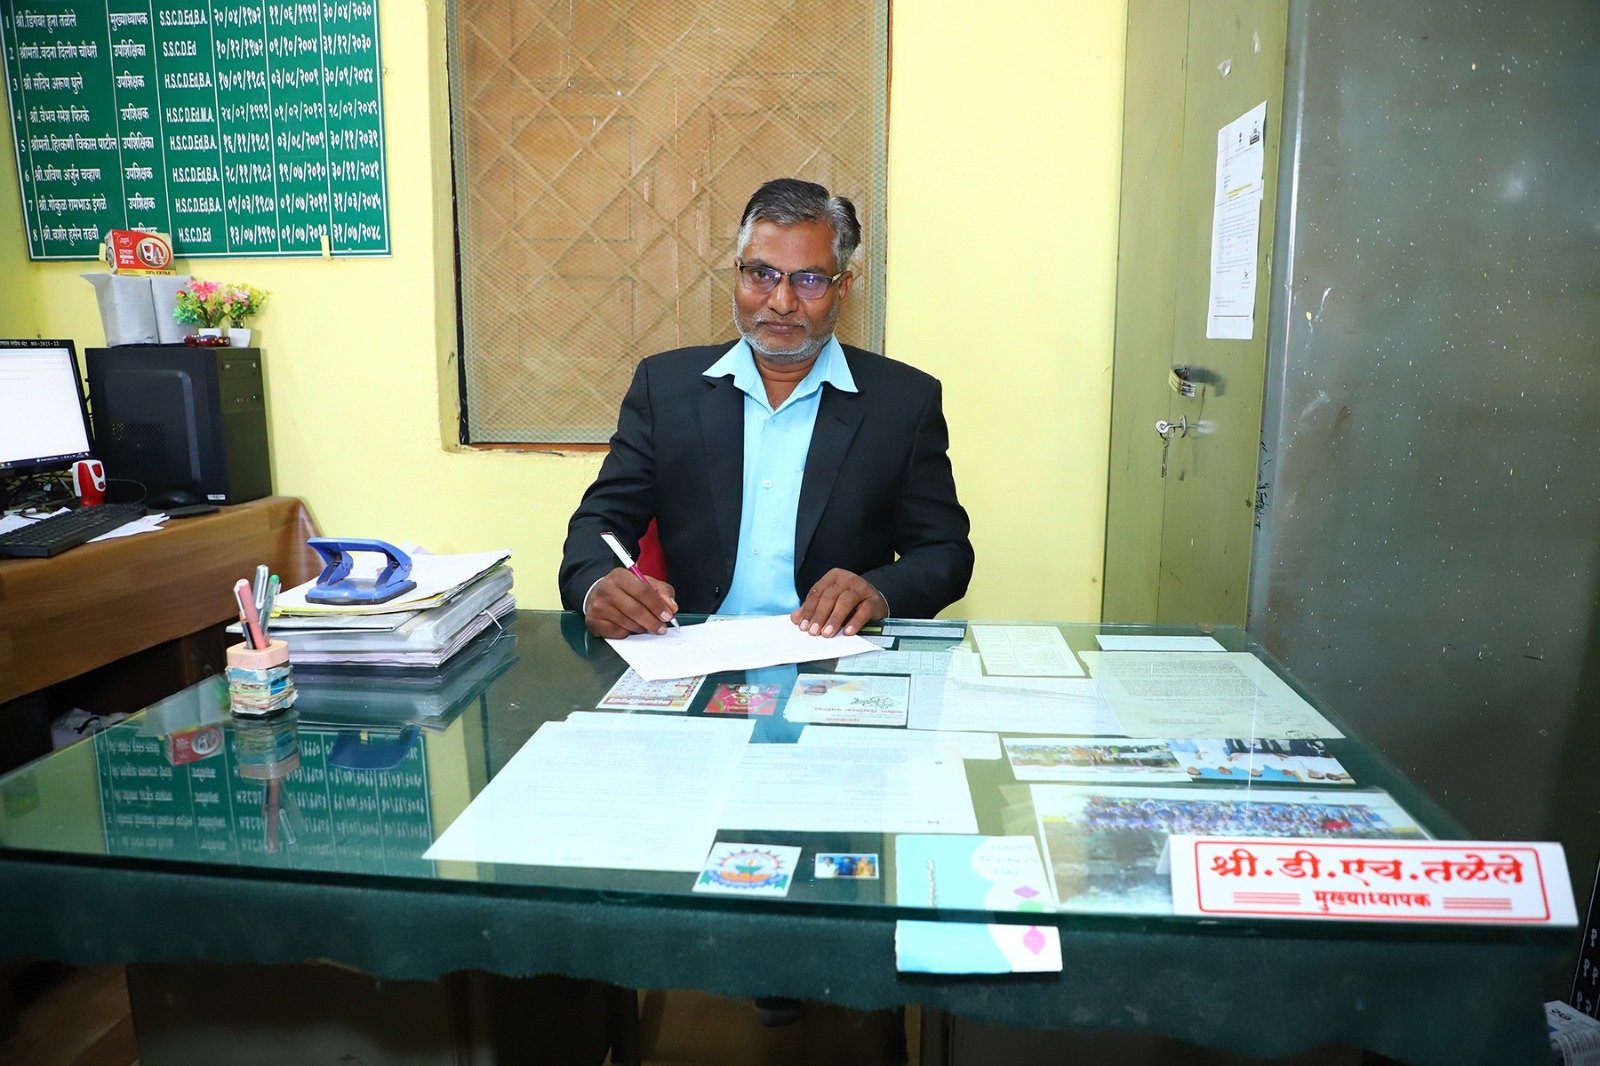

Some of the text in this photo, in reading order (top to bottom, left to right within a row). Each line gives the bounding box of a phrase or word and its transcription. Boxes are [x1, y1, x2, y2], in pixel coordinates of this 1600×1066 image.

[6, 16, 9, 28] 1
[59, 9, 76, 26] तळेले
[110, 13, 148, 31] मुख्याध्यापक
[214, 6, 262, 28] २०/०४/१९७२
[323, 1, 372, 23] ३०/०४/२०३०
[9, 47, 14, 59] 2
[57, 41, 77, 59] दिलीप
[78, 40, 97, 58] चौधरी
[113, 39, 146, 59] उपशिक्षिका
[217, 37, 263, 60] १०/१२/१९७२
[270, 35, 317, 58] ०९/१०/२००४
[323, 33, 371, 55] ३१/१२/२०३०
[13, 78, 18, 91] 3
[23, 74, 31, 90] श्री
[116, 70, 145, 90] उपशिक्षक
[219, 70, 266, 91] १७/०९/१९८६
[272, 68, 319, 89] ०३/०८/२००९
[325, 65, 373, 87] ३०/०९/२०४४
[17, 110, 21, 121] 4
[121, 103, 149, 122] उपशिक्षक
[329, 99, 377, 120] २८/०२/२०४९
[21, 140, 26, 152] 5
[75, 133, 96, 150] विकास
[98, 133, 117, 150] पाटील
[122, 132, 154, 151] उपशिक्षिका
[224, 132, 269, 153] १६/११/१९८१
[278, 130, 324, 151] ०३/०८/२००९
[330, 129, 378, 150] ३०/११/२०३९
[25, 170, 29, 182] 6
[125, 162, 153, 181] उपशिक्षक
[225, 164, 271, 184] २८/११/१९८३
[332, 160, 379, 181] ३०/११/२०४१
[29, 200, 32, 211] 7
[128, 192, 155, 211] उपशिक्षक
[334, 191, 381, 212] ३१/०३/२०४५
[33, 229, 38, 241] 8
[333, 223, 381, 243] ३१/०७/२०४८
[1210, 848, 1523, 886] श्री.डी.एच.तळेले
[1313, 890, 1431, 912] मुख्याध्यापक
